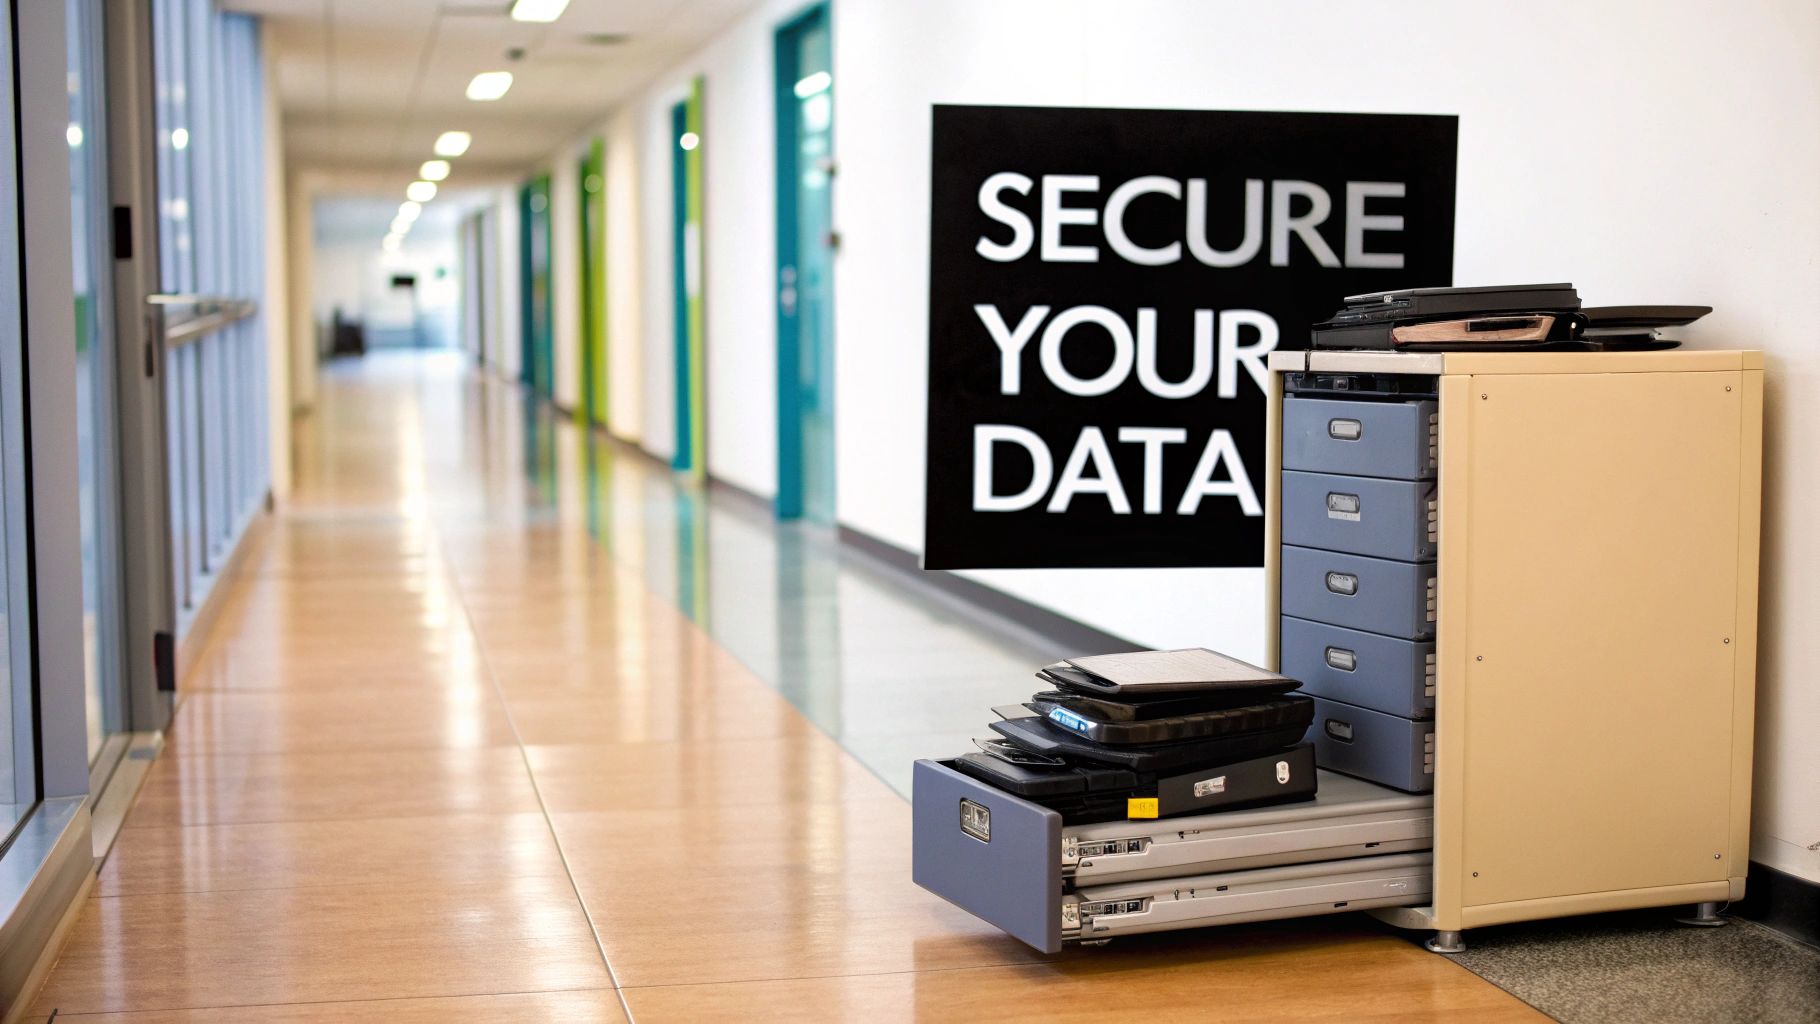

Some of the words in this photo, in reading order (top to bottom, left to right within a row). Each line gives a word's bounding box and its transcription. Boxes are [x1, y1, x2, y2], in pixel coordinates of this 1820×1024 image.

[975, 171, 1405, 267] SECURE
[973, 304, 1280, 399] YOUR
[972, 424, 1264, 516] DATA
